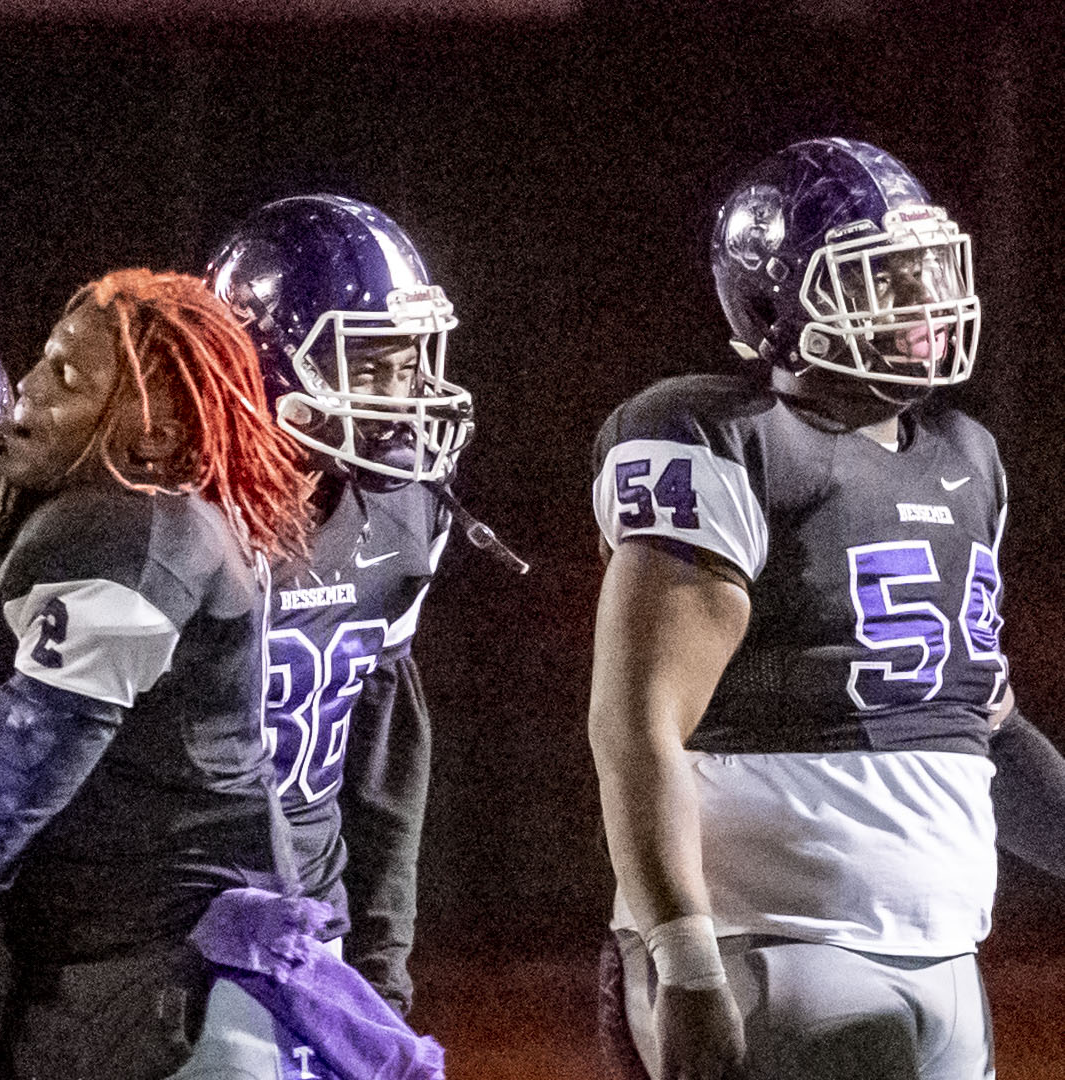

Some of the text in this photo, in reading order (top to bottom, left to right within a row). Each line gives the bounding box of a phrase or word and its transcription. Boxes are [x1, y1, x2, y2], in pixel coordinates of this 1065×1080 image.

[616, 458, 700, 530] 54
[29, 597, 69, 669] 2
[280, 583, 357, 611] BESSEMER
[846, 540, 1010, 711] 54
[267, 618, 390, 804] 86
